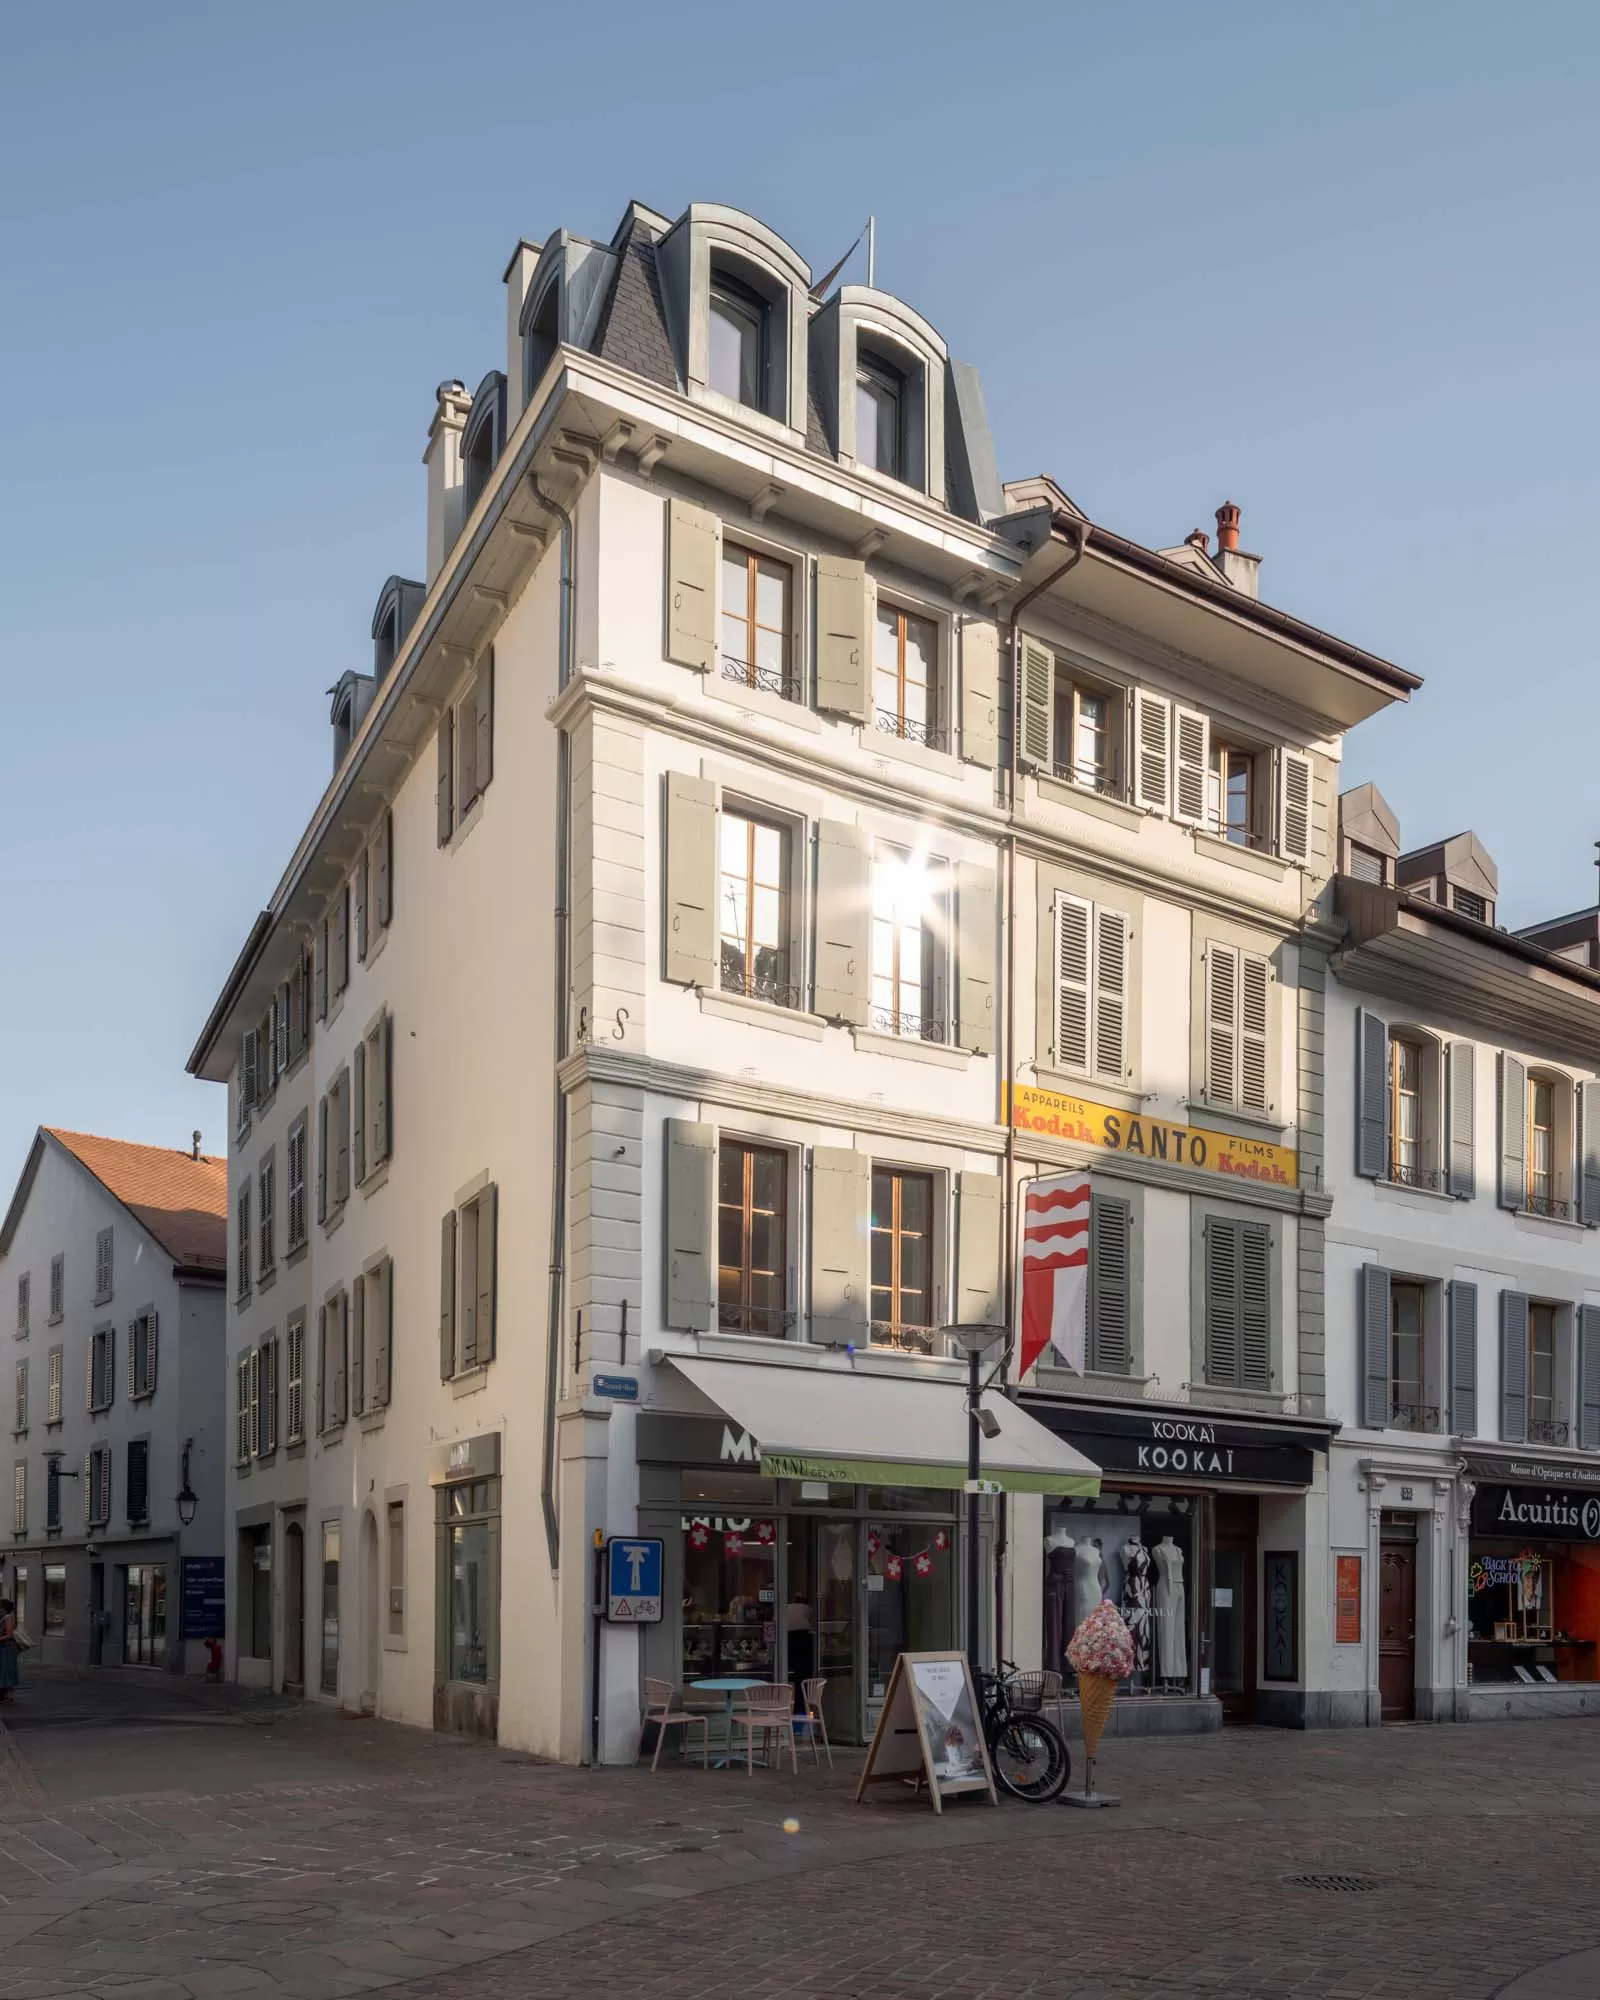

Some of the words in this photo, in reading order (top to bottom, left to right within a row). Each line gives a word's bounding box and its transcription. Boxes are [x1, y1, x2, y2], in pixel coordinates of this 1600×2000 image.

[1023, 1091, 1085, 1115] APPAREILS
[1013, 1104, 1096, 1144] Kodak
[1103, 1115, 1207, 1166] SANTO
[1229, 1139, 1274, 1159] FILMS
[1218, 1152, 1289, 1185] Kodak
[1151, 1421, 1215, 1444] KOOKAÏ
[1138, 1445, 1233, 1473] KOOKAÏ
[1565, 1471, 1572, 1479] et
[1498, 1488, 1579, 1526] Acuitis
[1481, 1556, 1506, 1570] BACK
